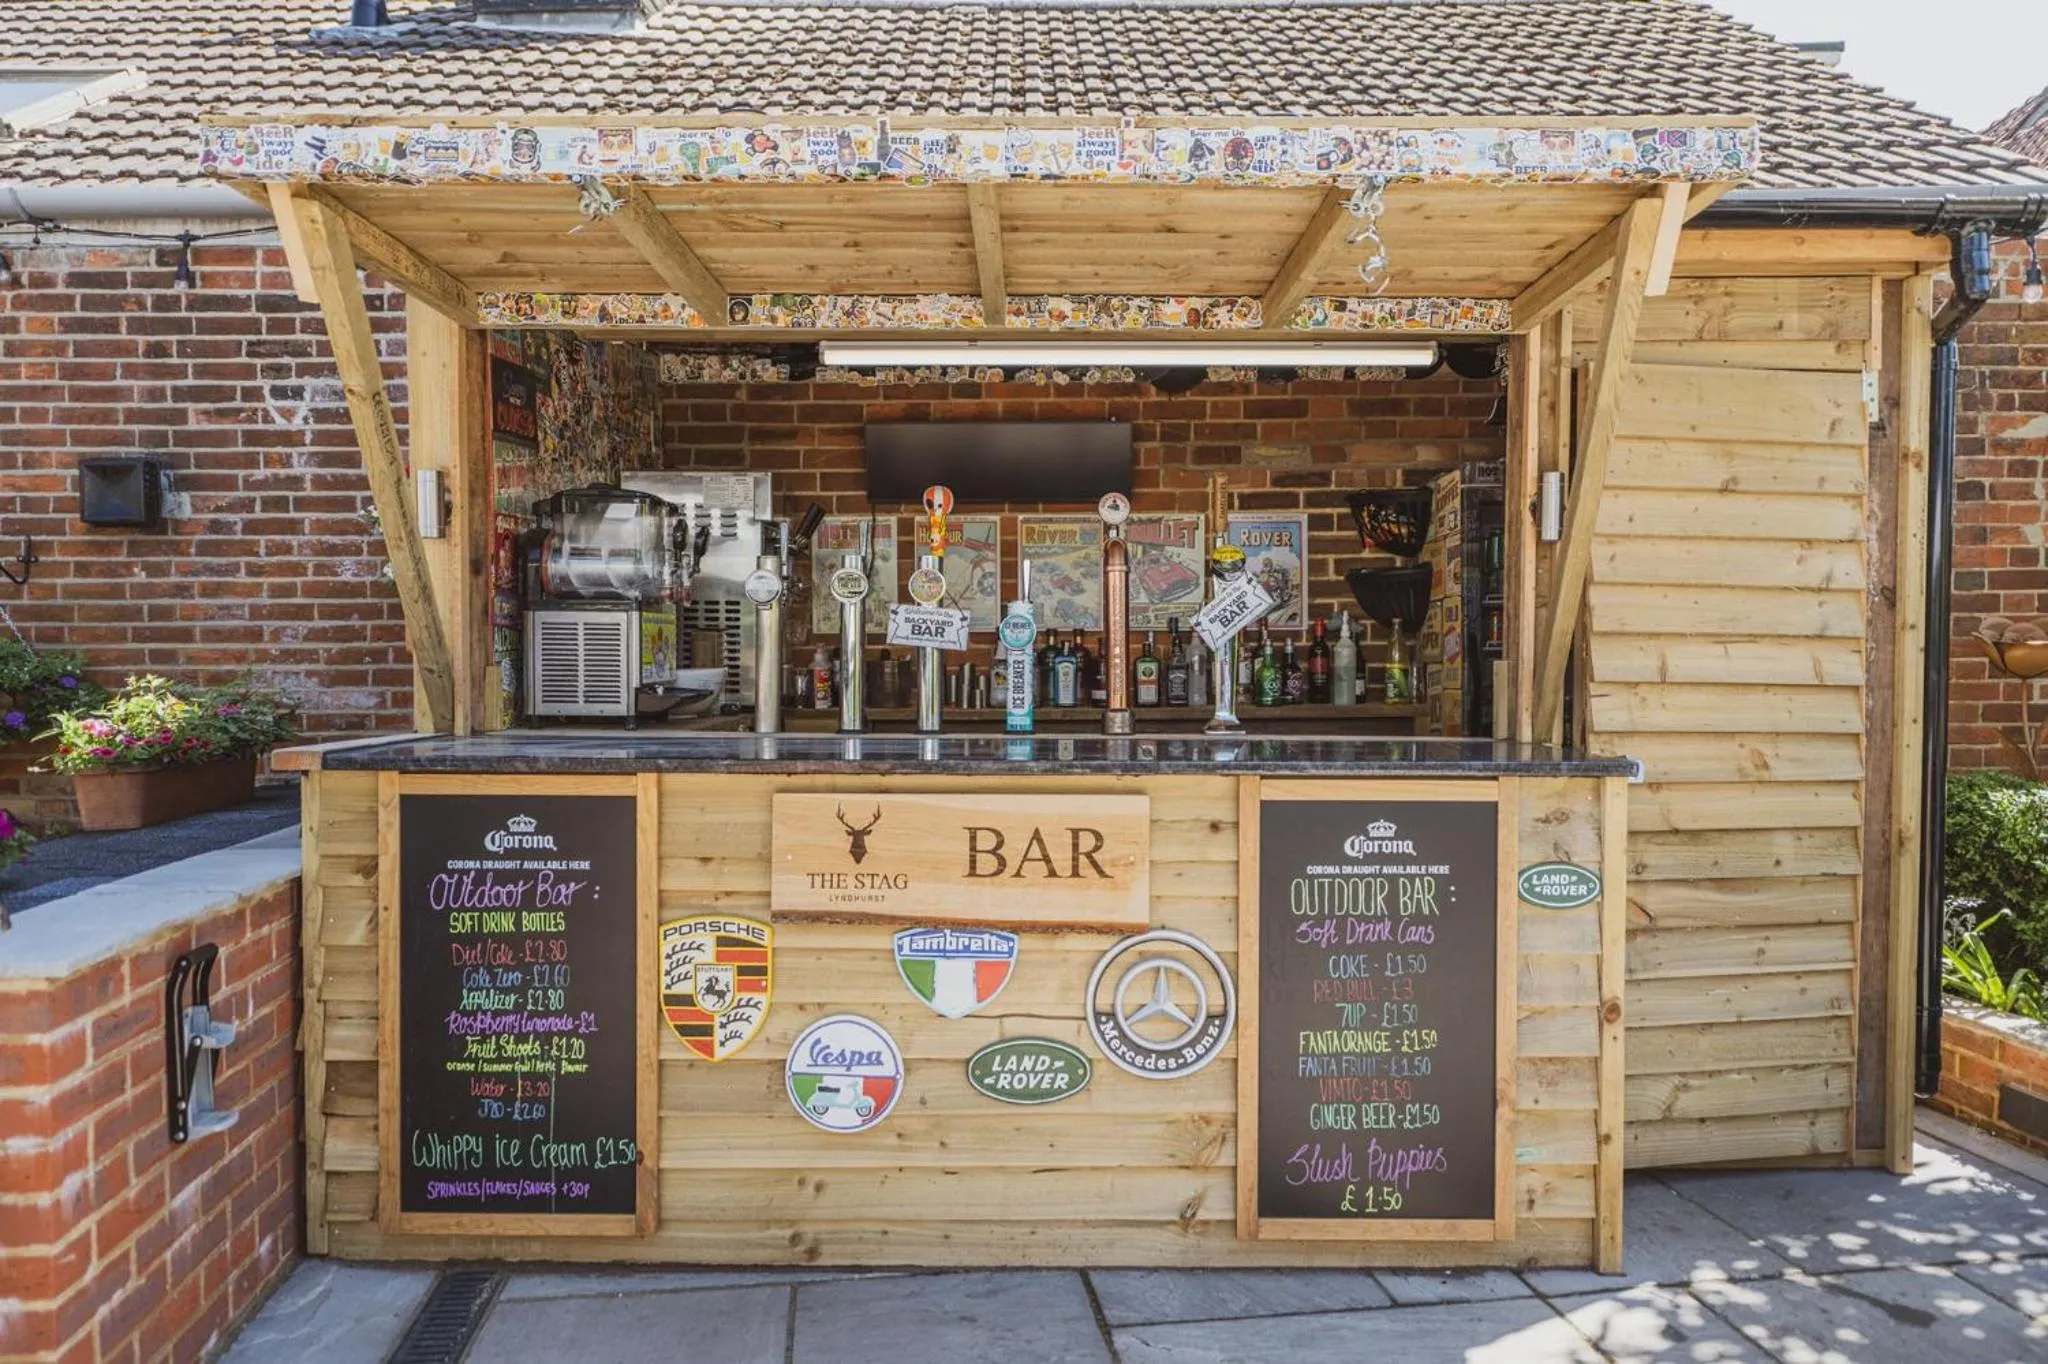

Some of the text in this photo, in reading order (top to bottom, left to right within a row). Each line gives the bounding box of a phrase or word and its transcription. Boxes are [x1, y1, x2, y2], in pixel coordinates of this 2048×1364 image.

[260, 139, 294, 148] lways
[1239, 529, 1294, 547] ROVER
[1208, 590, 1248, 625] BACKYARD
[1218, 600, 1250, 629] BAR
[904, 616, 954, 628] BACKYARD
[911, 624, 946, 638] BAR
[1013, 659, 1025, 694] BREAKER
[484, 830, 557, 854] Corona
[962, 825, 1115, 880] BAR
[1344, 836, 1417, 859] Corona
[447, 860, 591, 870] CORONA DRAUGHT AVAILABLE HERE
[1306, 865, 1450, 874] CORONA DRAUGHT AVAILABLE HERE
[807, 872, 909, 890] THE STAG
[1291, 878, 1389, 916] OUTDOOR
[1400, 876, 1440, 916] BAR
[449, 911, 566, 933] SOFT DRINK BOTTLES
[663, 920, 766, 942] PORSCHE
[1296, 917, 1435, 949] Soft Drink Cans
[463, 966, 493, 988] Coke
[493, 967, 523, 987] Zero
[1329, 954, 1369, 978] COKE
[1313, 980, 1343, 1002] RED
[1335, 1003, 1367, 1028] 7UP
[464, 1035, 498, 1059] Fruit
[499, 1034, 541, 1059] Shoots
[807, 1037, 885, 1073] Vespa
[1099, 1018, 1221, 1070] Mercedes-Benz
[1299, 1057, 1338, 1078] FANTA
[470, 1077, 506, 1097] Water
[1310, 1103, 1357, 1130] GINGER
[495, 1132, 522, 1168] ice
[530, 1133, 588, 1170] Cream
[594, 1136, 637, 1170] £1.50
[1285, 1136, 1448, 1190] Slush Puppies
